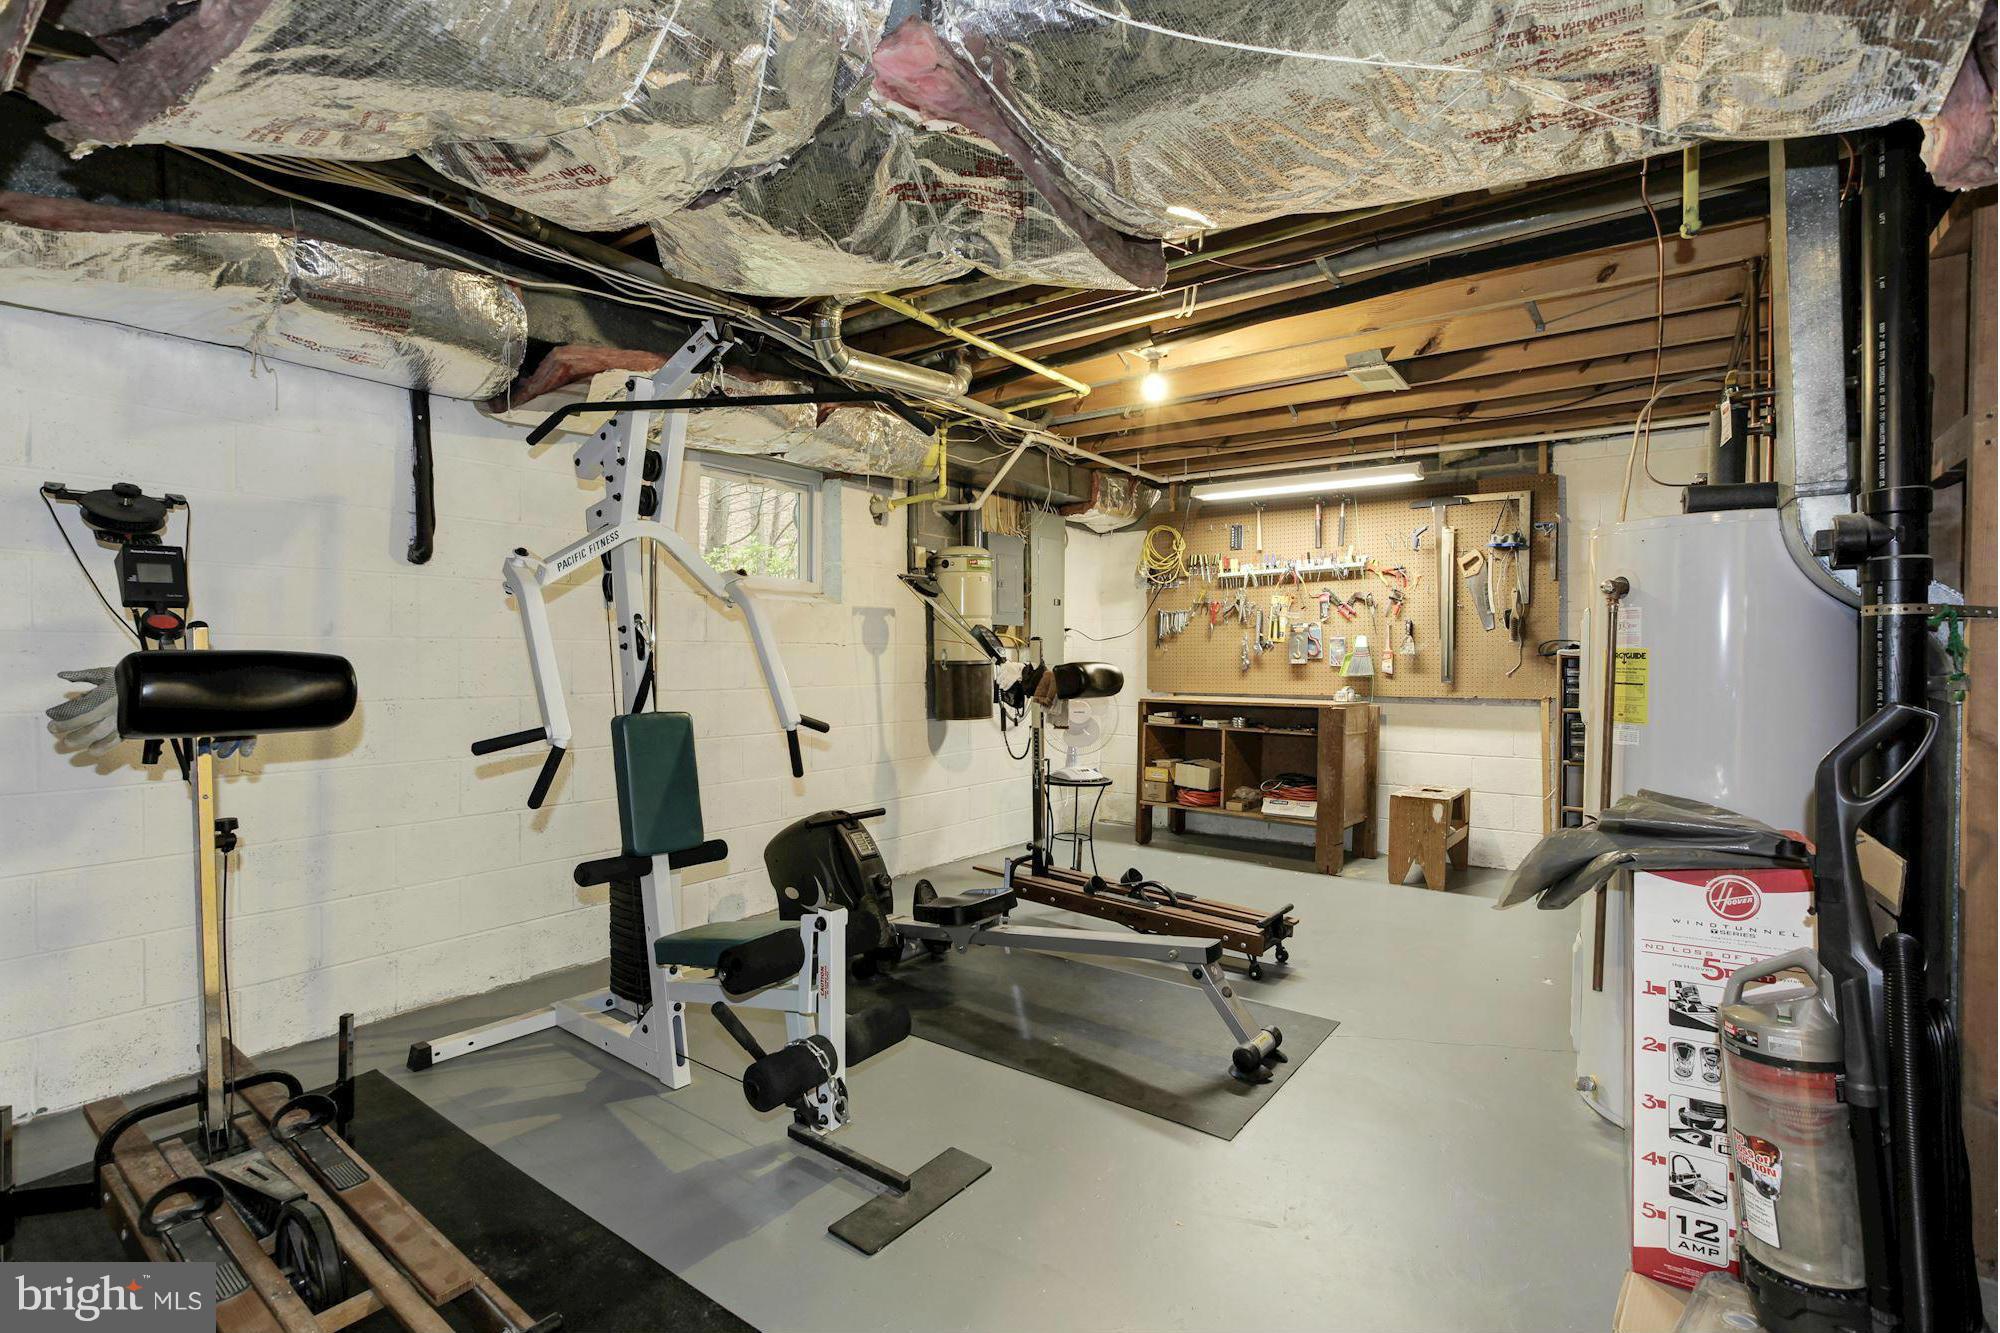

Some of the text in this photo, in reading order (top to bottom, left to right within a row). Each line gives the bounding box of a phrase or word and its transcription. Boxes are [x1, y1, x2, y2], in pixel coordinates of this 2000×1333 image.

[557, 530, 620, 572] PACIFIC FITNESS
[1671, 918, 1801, 938] WINDTUNNEL
[1719, 929, 1757, 939] SERIES
[1643, 943, 1665, 951] NO
[1672, 946, 1714, 957] LOSS
[1721, 952, 1742, 961] OF
[1701, 957, 1725, 980] 5
[1642, 980, 1656, 995] 1
[1642, 1037, 1658, 1052] 2
[1642, 1094, 1657, 1109] 3
[1642, 1151, 1657, 1166] 4
[1642, 1202, 1657, 1218] 5
[1676, 1214, 1720, 1243] 12
[1678, 1241, 1720, 1256] AMP
